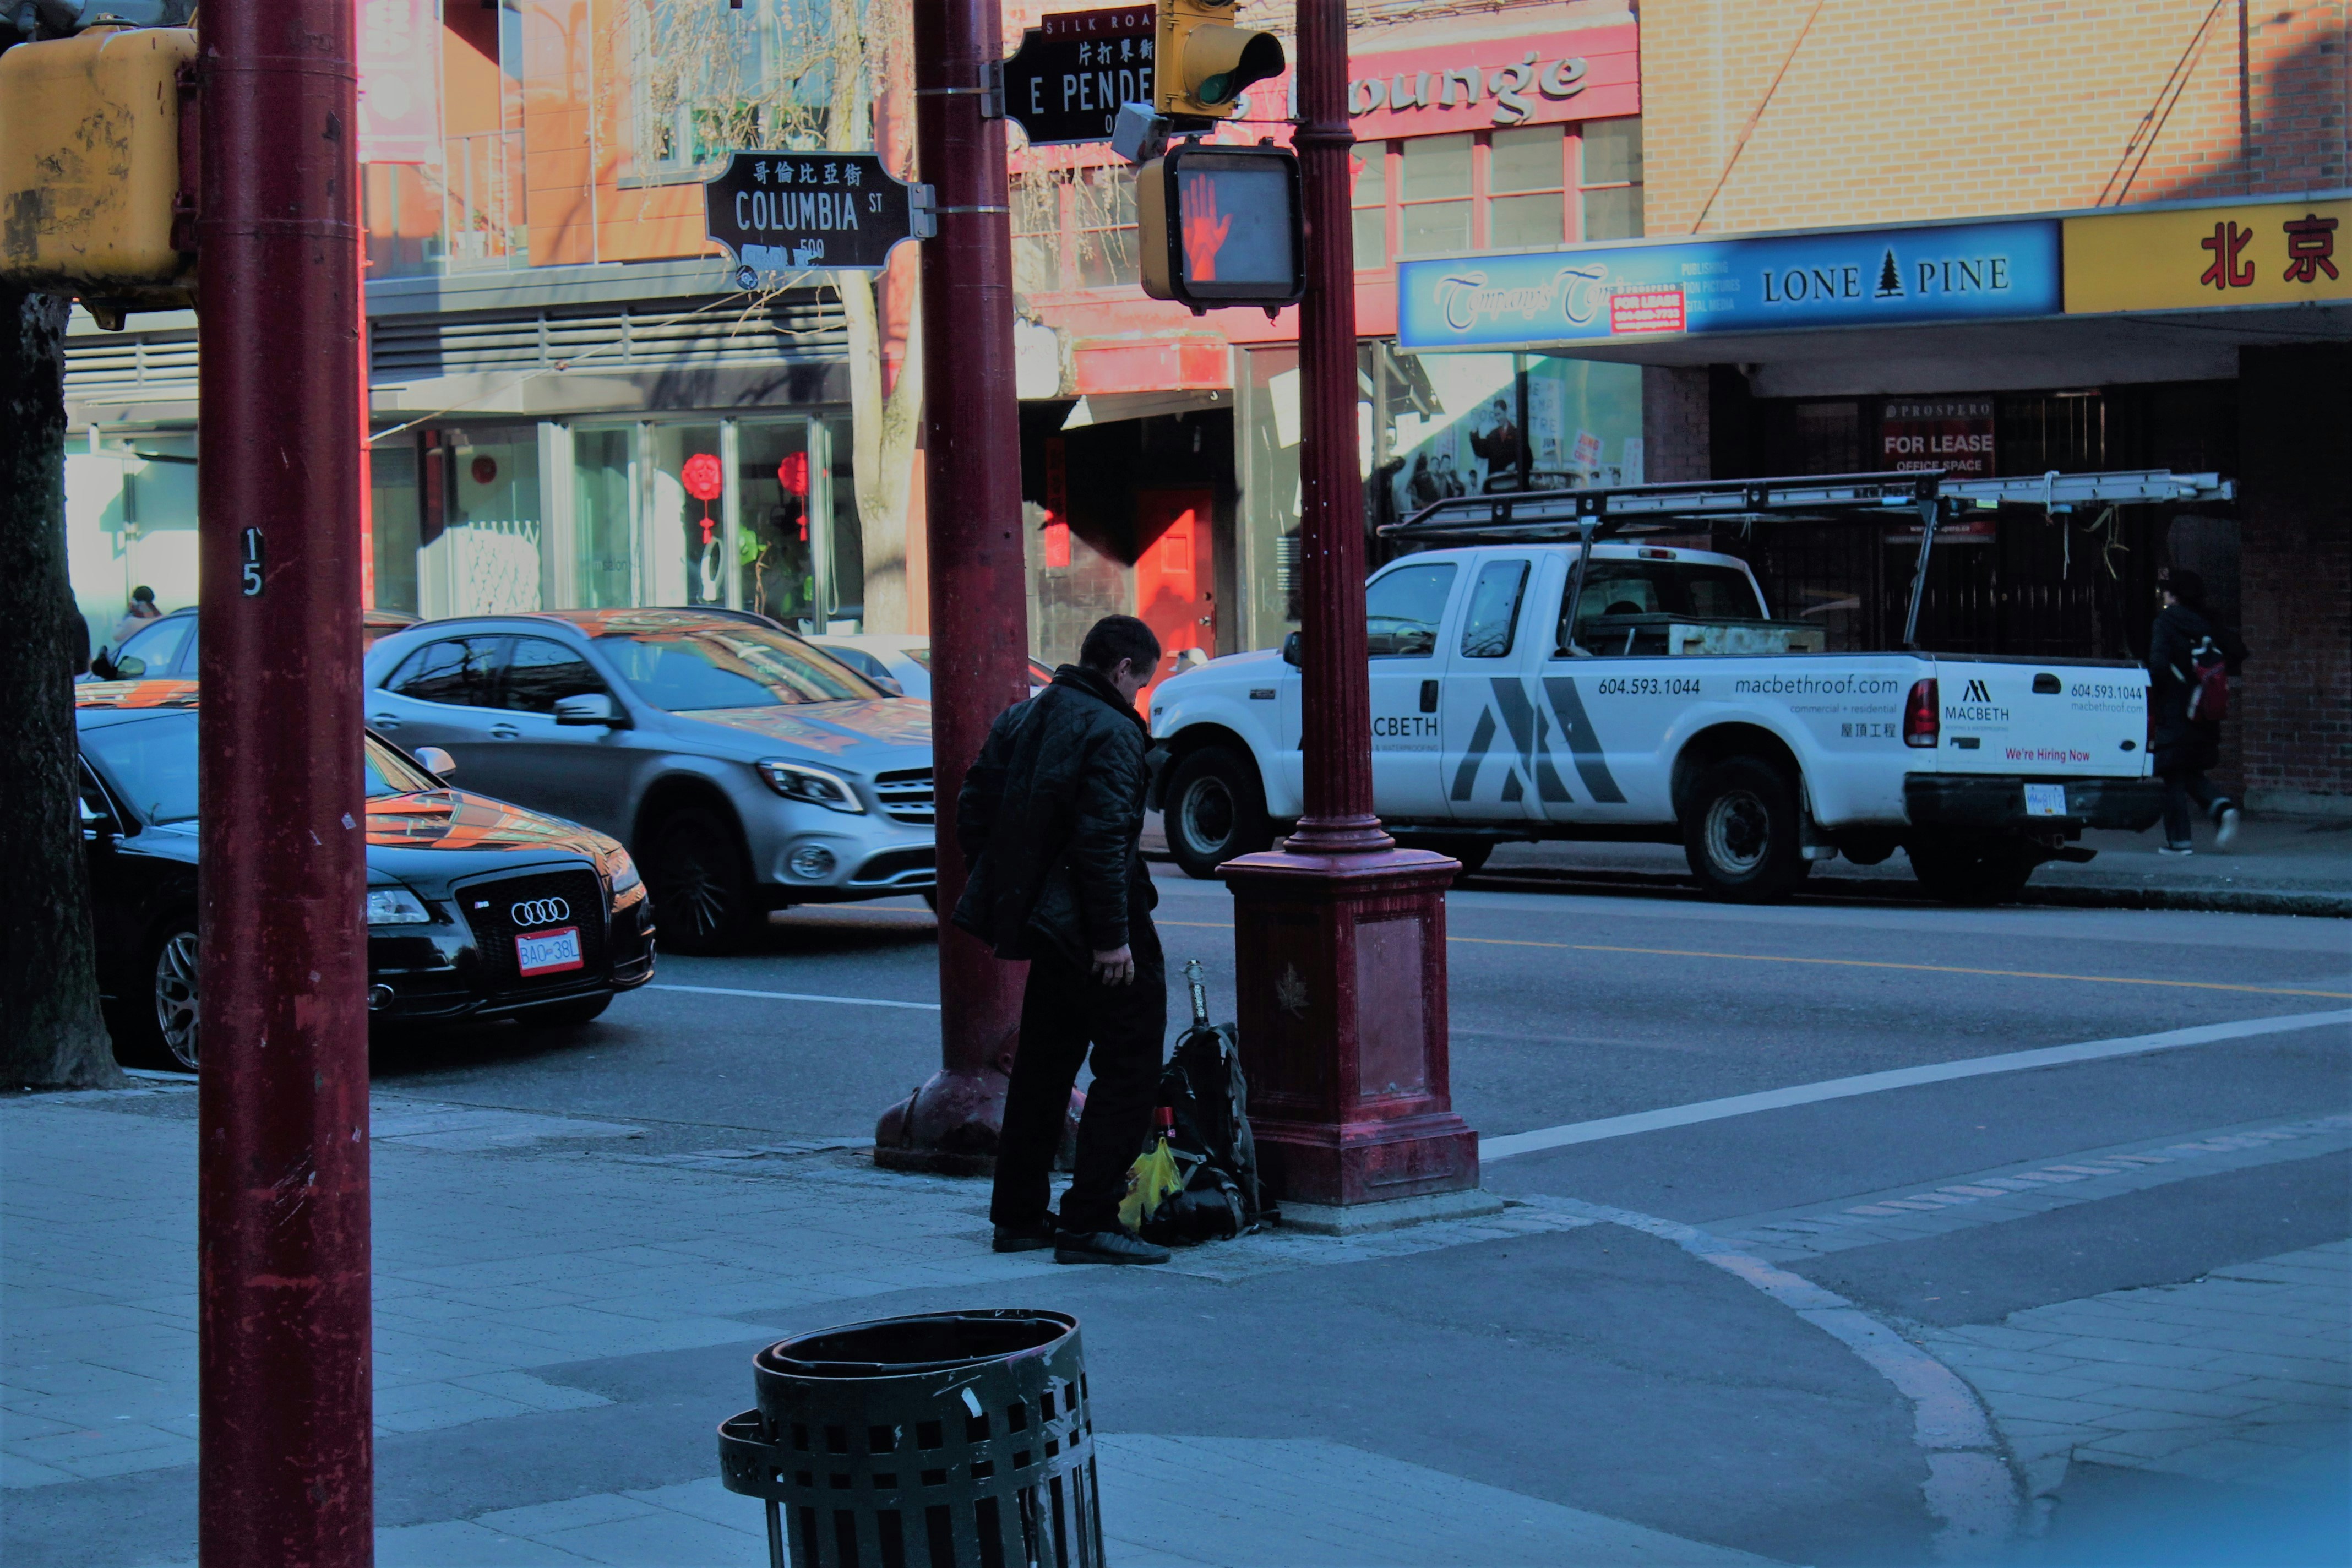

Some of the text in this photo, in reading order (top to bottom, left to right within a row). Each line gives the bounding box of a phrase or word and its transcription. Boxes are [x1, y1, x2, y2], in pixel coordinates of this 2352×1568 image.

[1046, 14, 1150, 34] SILK ROA
[1030, 67, 1154, 114] E PENDE
[1288, 51, 1589, 124] ounge
[736, 190, 883, 231] COLUMBIA ST
[799, 238, 825, 259] 500
[2200, 214, 2340, 291] 北京
[1681, 260, 1728, 276] PUBLISHING
[1762, 257, 2010, 304] LONE PINE
[1626, 284, 1676, 294] PROSPERO
[1614, 294, 1680, 310] FOR LEASE
[1901, 404, 1990, 417] PROSPERO
[1885, 434, 1993, 454] FOR LEASE
[1897, 460, 1982, 471] OFFICE SPACE
[1598, 678, 1701, 695] 604.593.1044
[1735, 674, 1899, 694] macbethroof.com
[2071, 684, 2142, 700] 604.593.1044
[1790, 704, 1840, 714] commercial
[1851, 704, 1897, 714] residential
[1945, 706, 2010, 722] MACBETH
[2071, 701, 2144, 714] macbethroof.com
[1372, 717, 1438, 737] CBETH
[1840, 722, 1897, 738] 屋頂工程
[2005, 748, 2090, 763] We're Hiring Now
